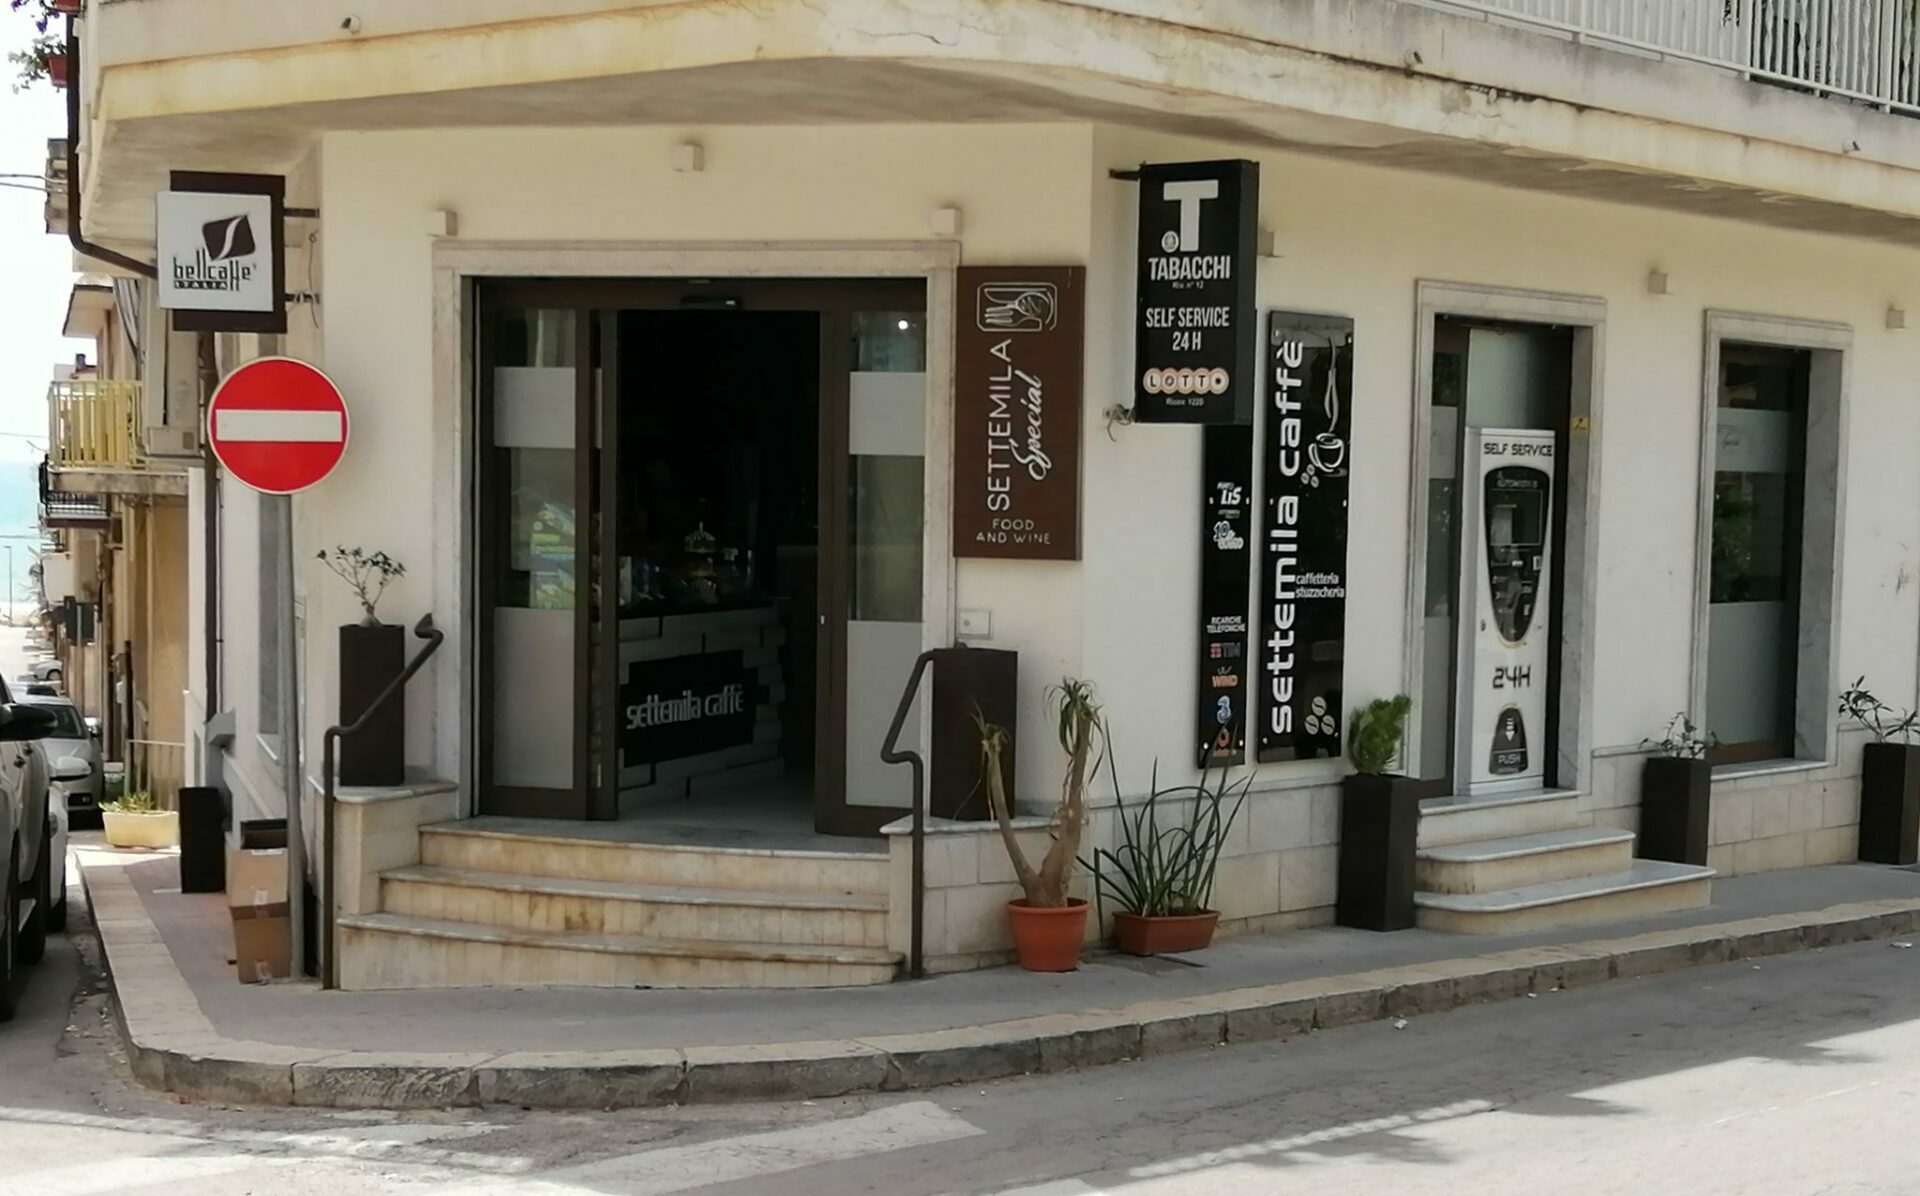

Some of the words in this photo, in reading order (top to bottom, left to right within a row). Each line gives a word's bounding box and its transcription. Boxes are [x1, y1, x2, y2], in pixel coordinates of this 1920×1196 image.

[1163, 179, 1219, 252] T
[1148, 255, 1231, 281] TABACCHI
[1146, 306, 1176, 328] SELF
[1178, 306, 1230, 327] SERVICE
[1172, 331, 1190, 351] 24
[1192, 331, 1202, 351] H
[1146, 371, 1225, 391] LOTTO
[1275, 341, 1303, 477] caffè
[987, 338, 1012, 512] SETTEMILA
[1009, 368, 1053, 481] Special
[1484, 442, 1508, 456] SELF
[1511, 443, 1553, 457] SERVICE
[992, 518, 1034, 531] FOOD
[976, 532, 1007, 544] AND
[1014, 533, 1051, 545] WINE
[1296, 572, 1339, 585] caffetteria
[1266, 495, 1299, 734] settemila
[1212, 675, 1238, 688] WIND
[1493, 665, 1531, 689] 24H
[626, 690, 702, 731] settemila
